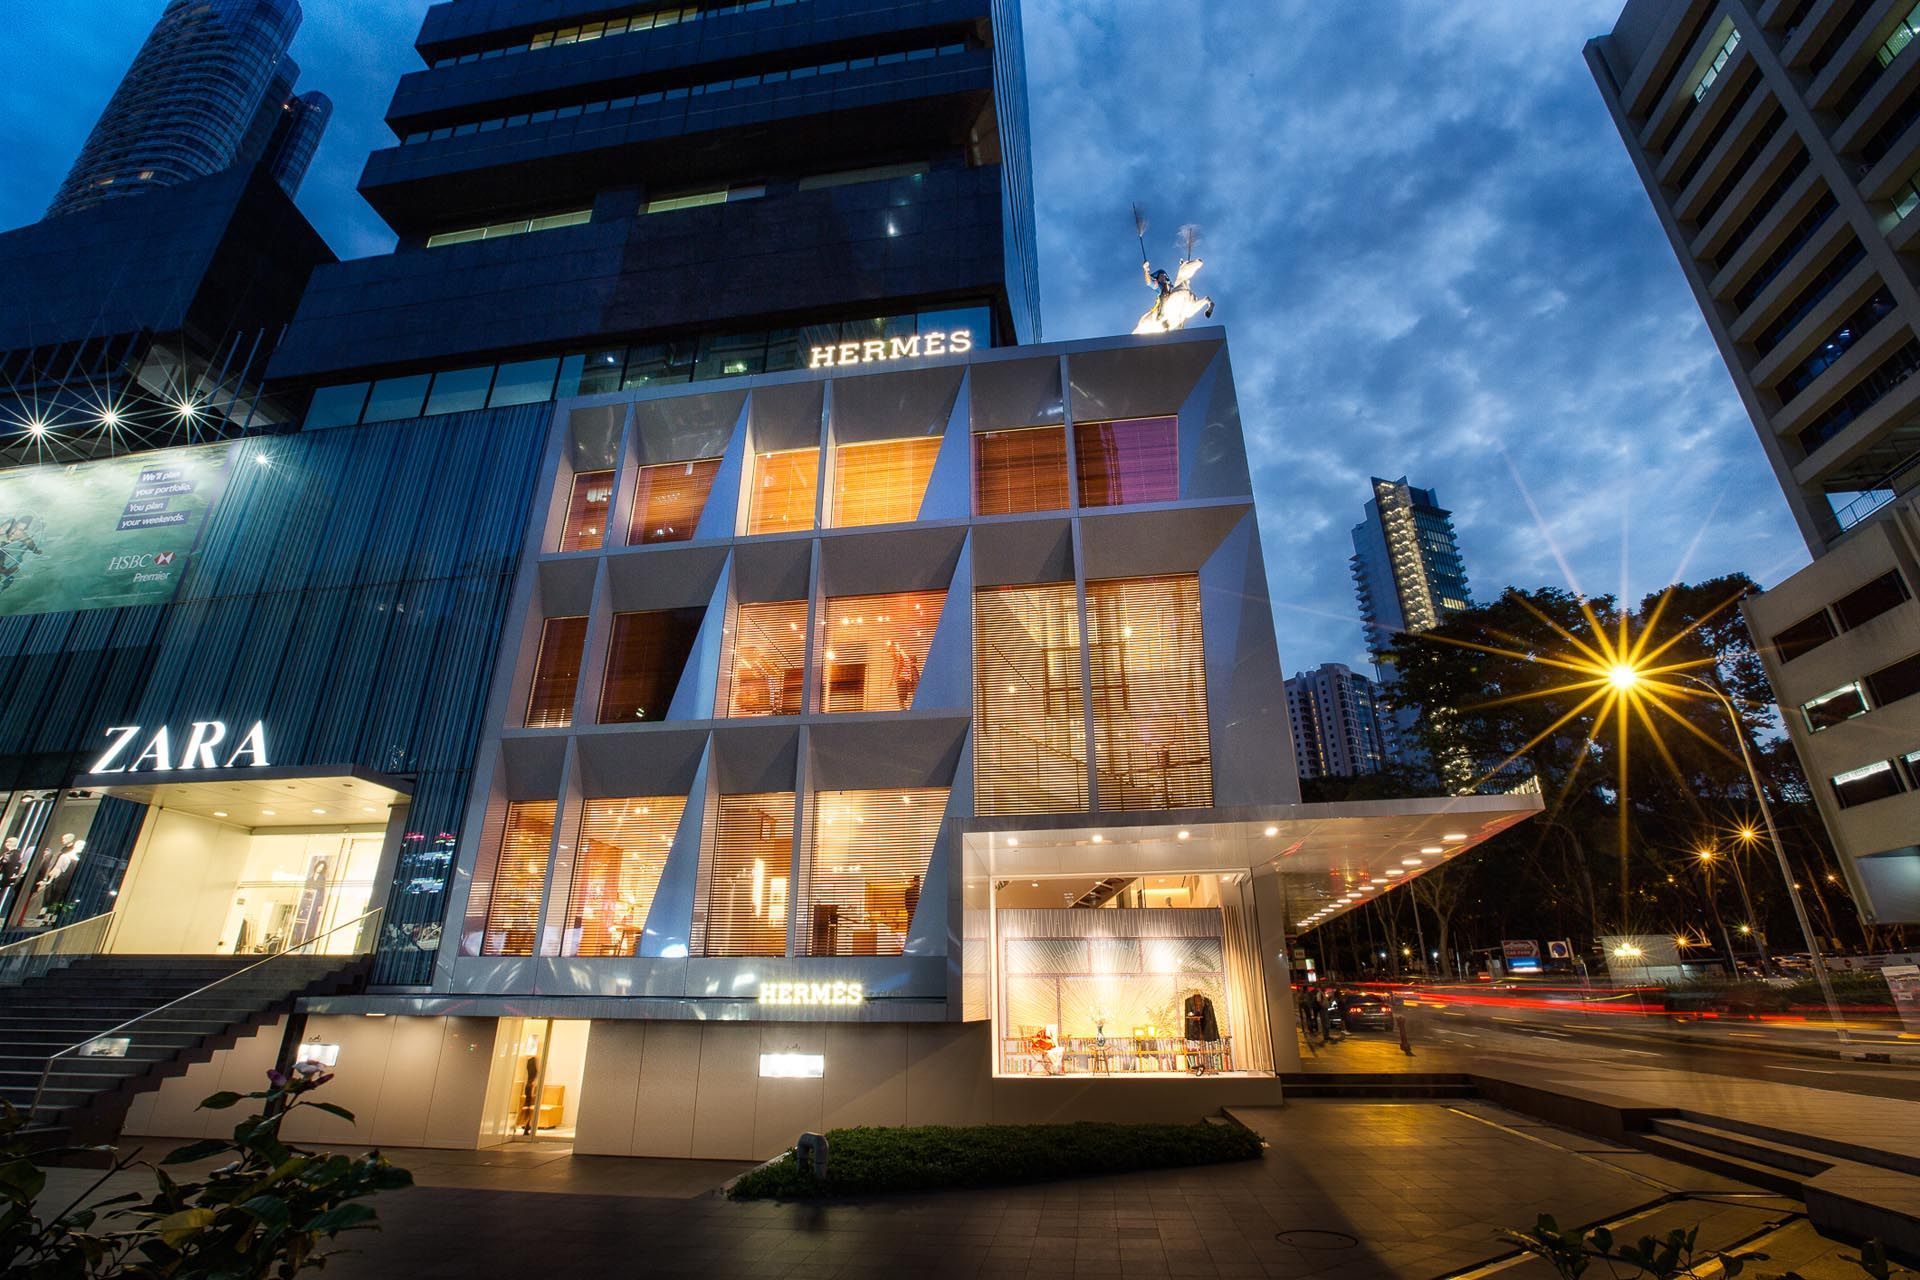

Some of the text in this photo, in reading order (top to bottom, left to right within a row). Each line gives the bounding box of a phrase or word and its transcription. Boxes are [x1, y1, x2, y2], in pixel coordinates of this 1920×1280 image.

[163, 471, 181, 481] plan
[135, 483, 192, 497] your portfolio.
[129, 502, 163, 512] You plan
[121, 513, 184, 528] your weekends.
[108, 553, 152, 570] HSBC
[133, 571, 171, 583] Premier
[88, 719, 271, 774] ZARA
